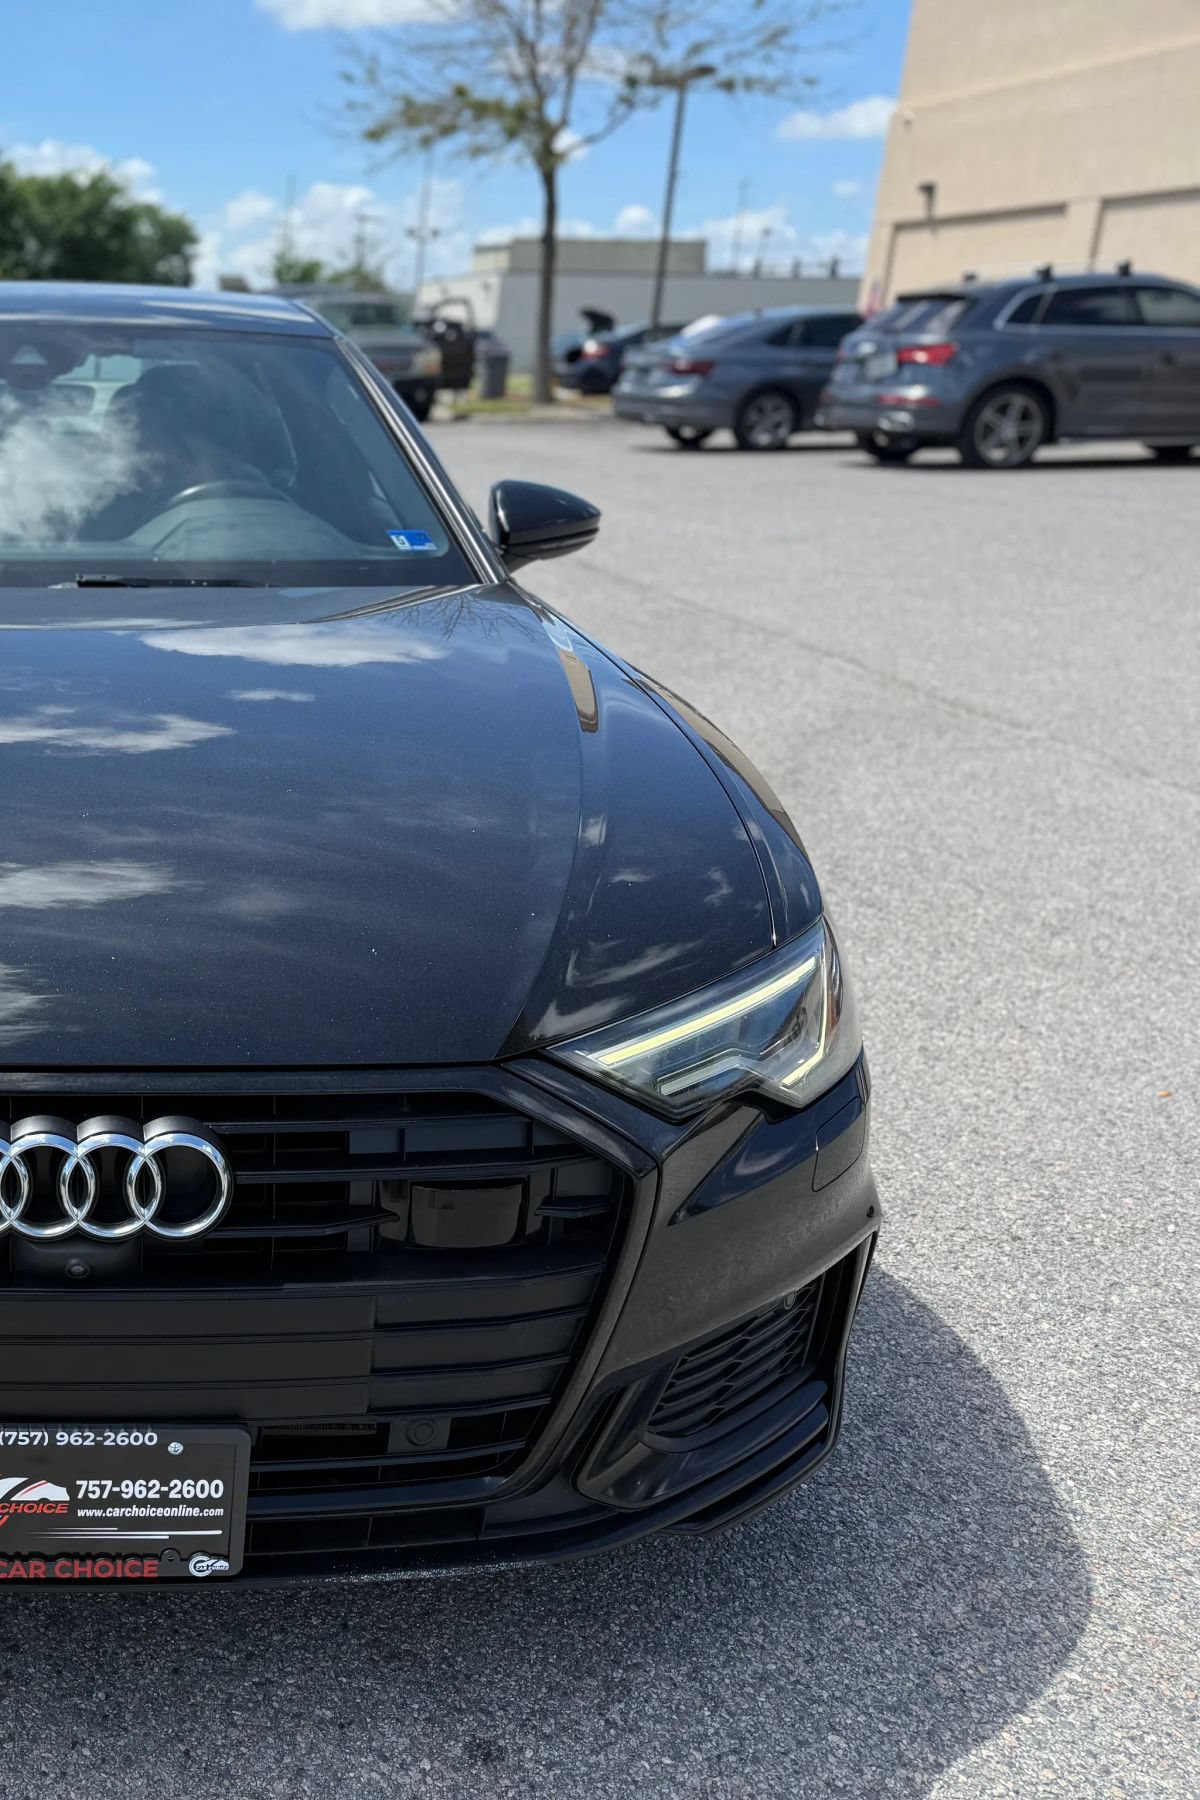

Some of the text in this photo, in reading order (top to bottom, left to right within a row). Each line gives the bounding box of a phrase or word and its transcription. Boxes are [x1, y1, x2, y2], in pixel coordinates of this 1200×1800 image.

[55, 1431, 158, 1446] 962-2600
[75, 1479, 224, 1499] 757-962-2600
[77, 1504, 224, 1517] www.carchoiceonline.com
[54, 1558, 160, 1579] CHOICE
